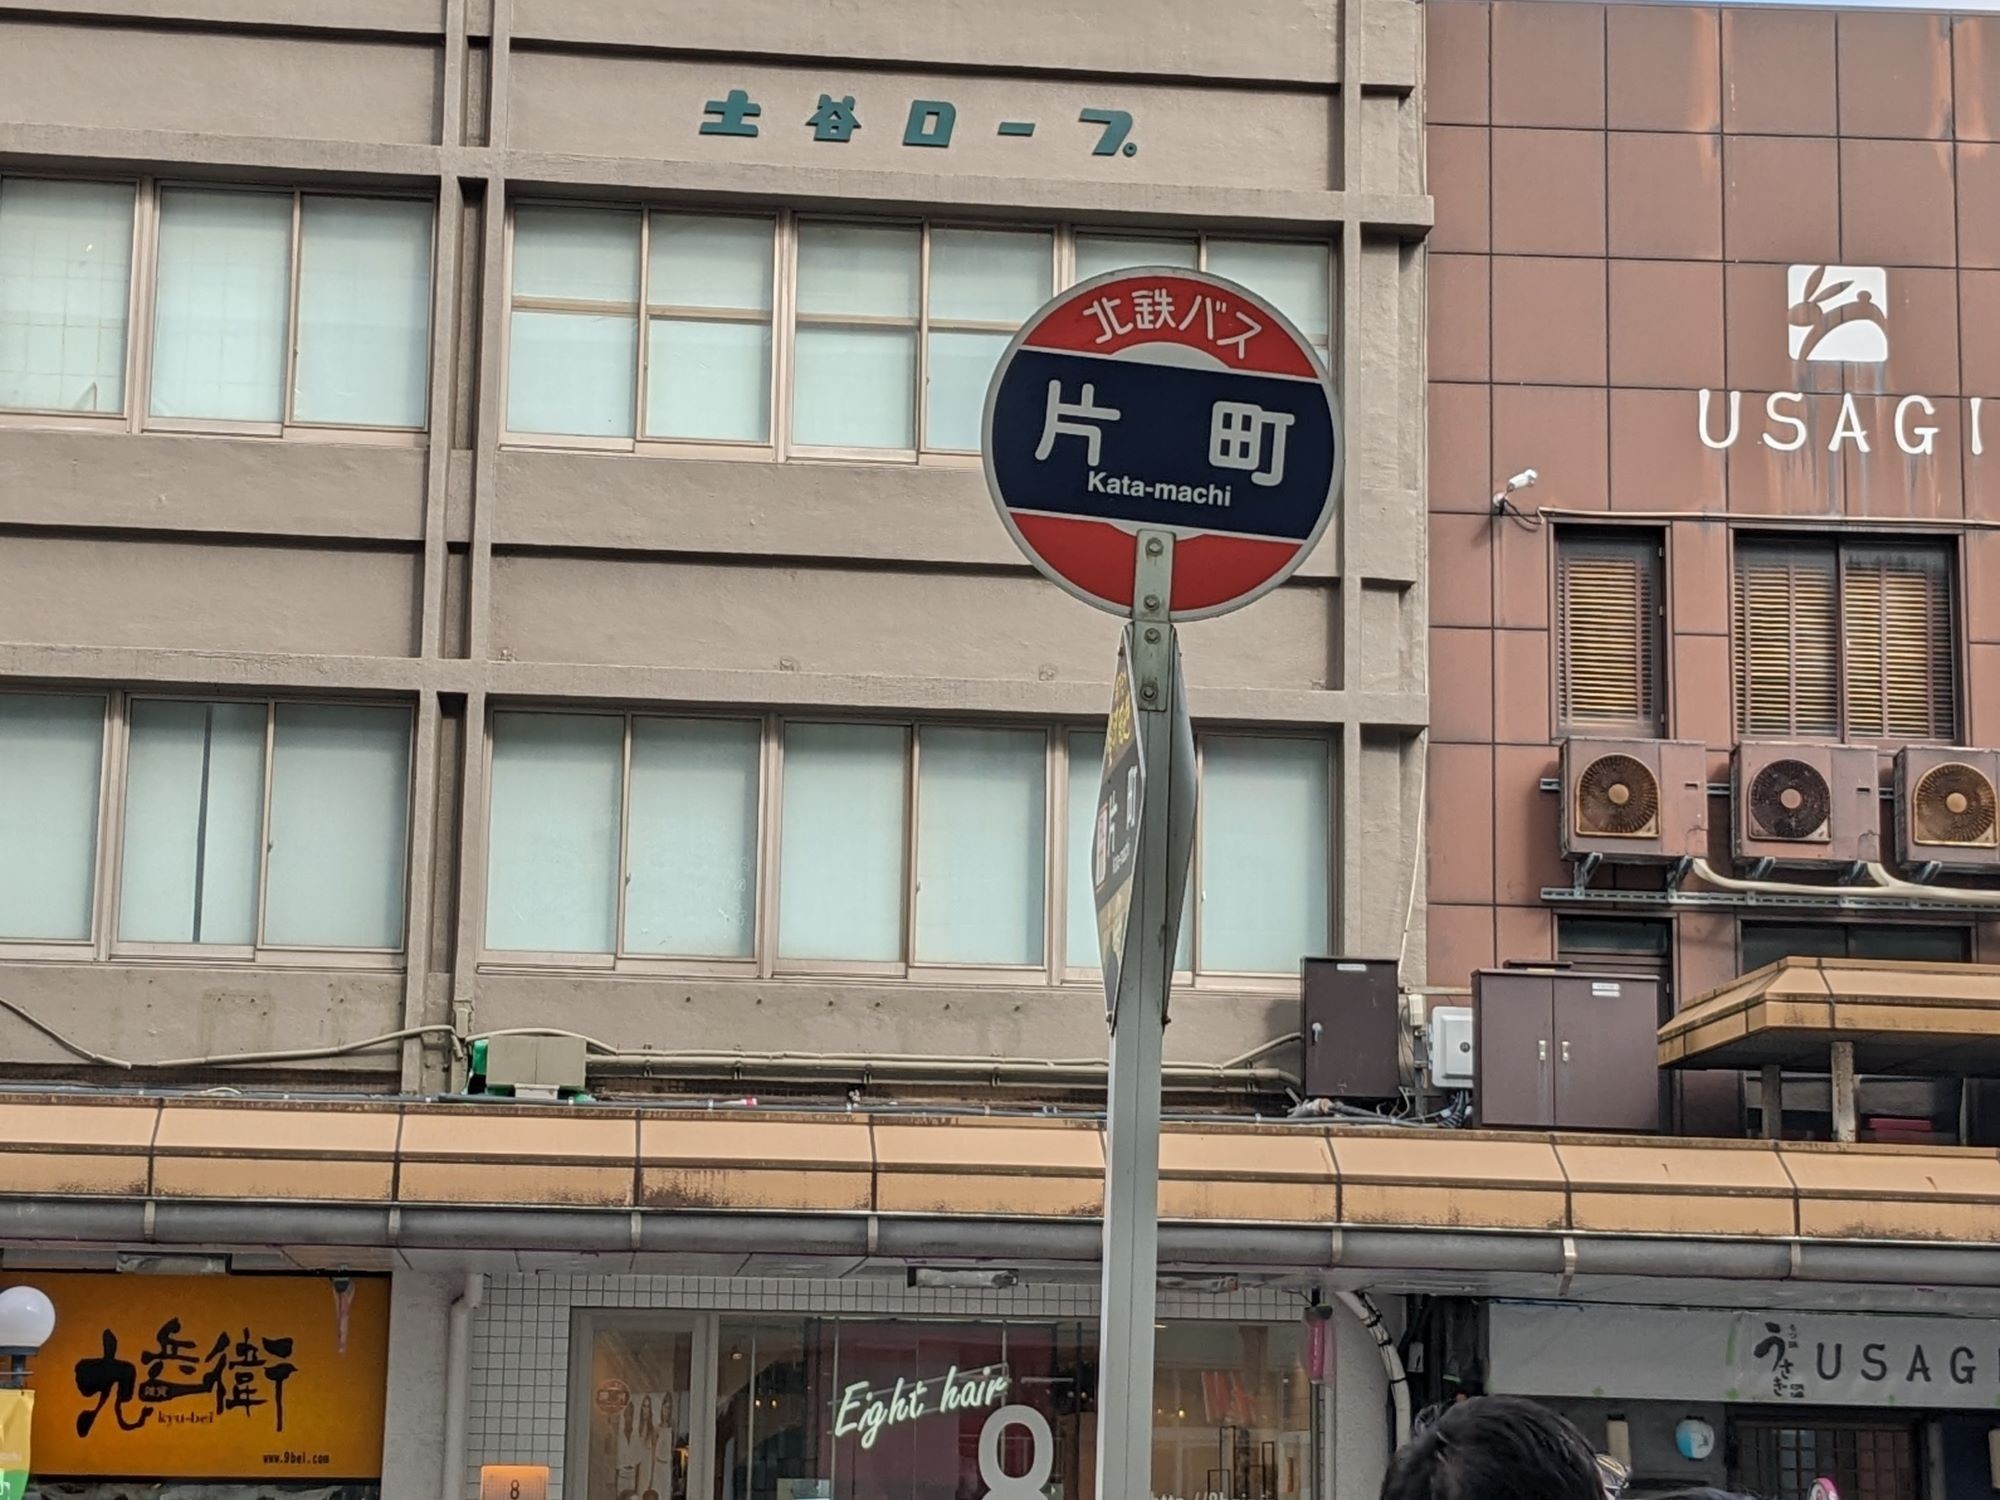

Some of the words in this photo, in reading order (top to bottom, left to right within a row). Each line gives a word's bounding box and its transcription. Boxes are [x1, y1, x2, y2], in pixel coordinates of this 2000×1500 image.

[699, 89, 1138, 157] 土谷ロープ
[1083, 288, 1262, 359] 北鉄バス
[1034, 379, 1296, 487] 片町
[1699, 388, 1983, 455] USAGI
[1087, 470, 1232, 507] Kata-machi
[1753, 1321, 1794, 1398] うさぎ
[1815, 1342, 2000, 1385] USAG
[157, 1411, 214, 1429] kyu-bei
[834, 1376, 928, 1449] Eight
[939, 1365, 1009, 1413] hair
